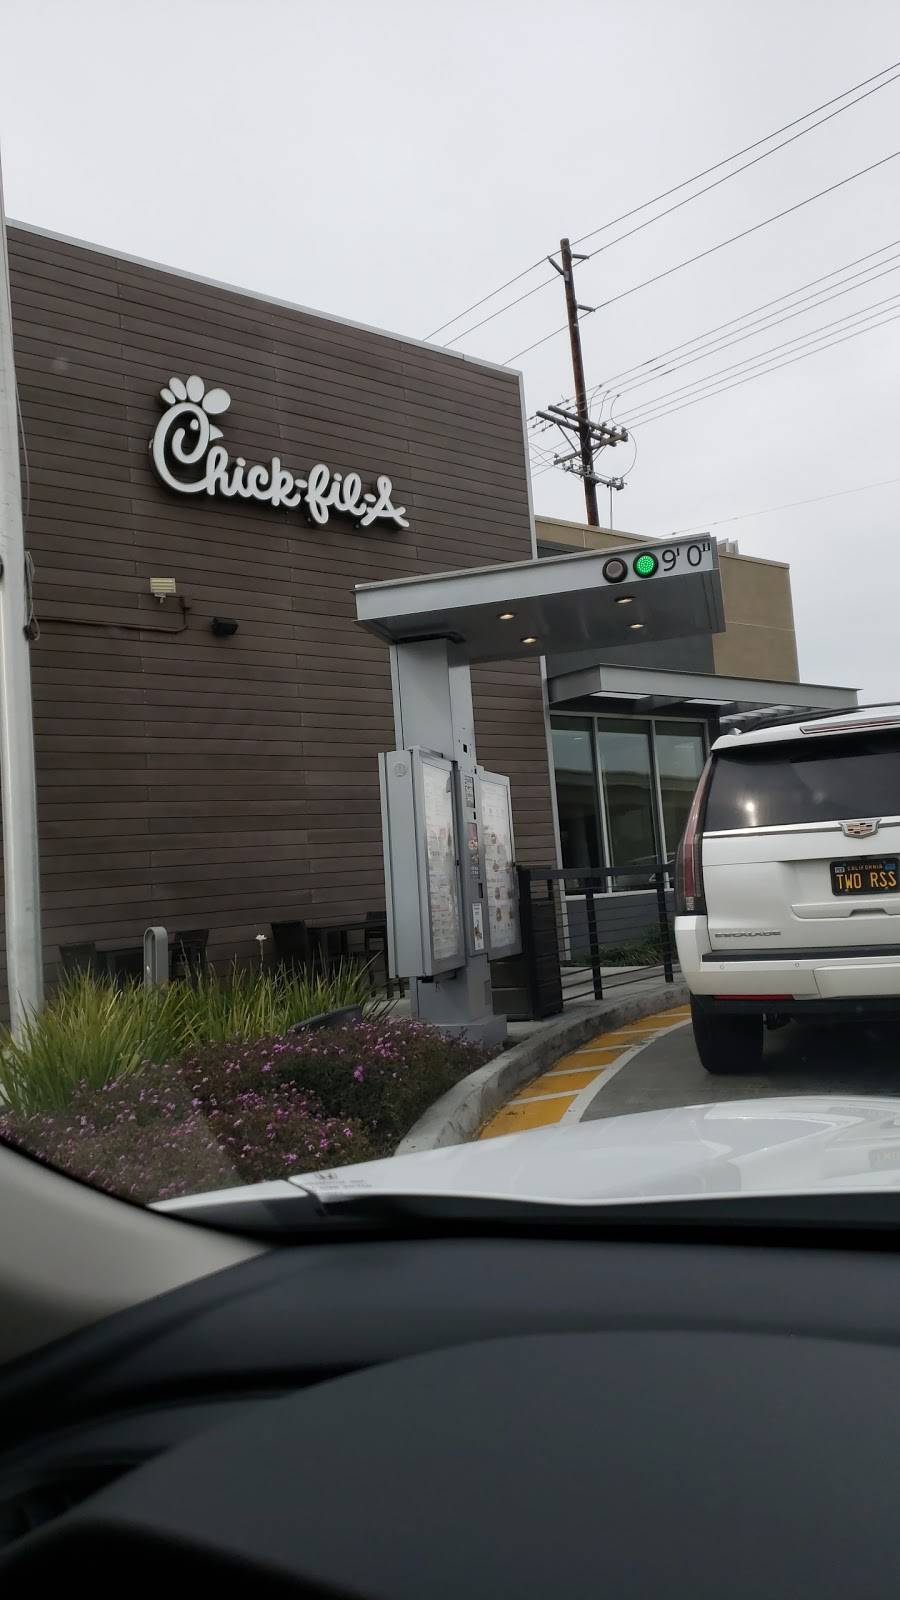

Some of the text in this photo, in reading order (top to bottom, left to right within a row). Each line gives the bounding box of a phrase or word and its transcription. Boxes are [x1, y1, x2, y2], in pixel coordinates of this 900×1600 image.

[152, 375, 410, 528] Chick-fil-A
[661, 547, 681, 572] 9'
[847, 863, 883, 872] CALIFORNIA
[836, 870, 897, 890] TWO RSS
